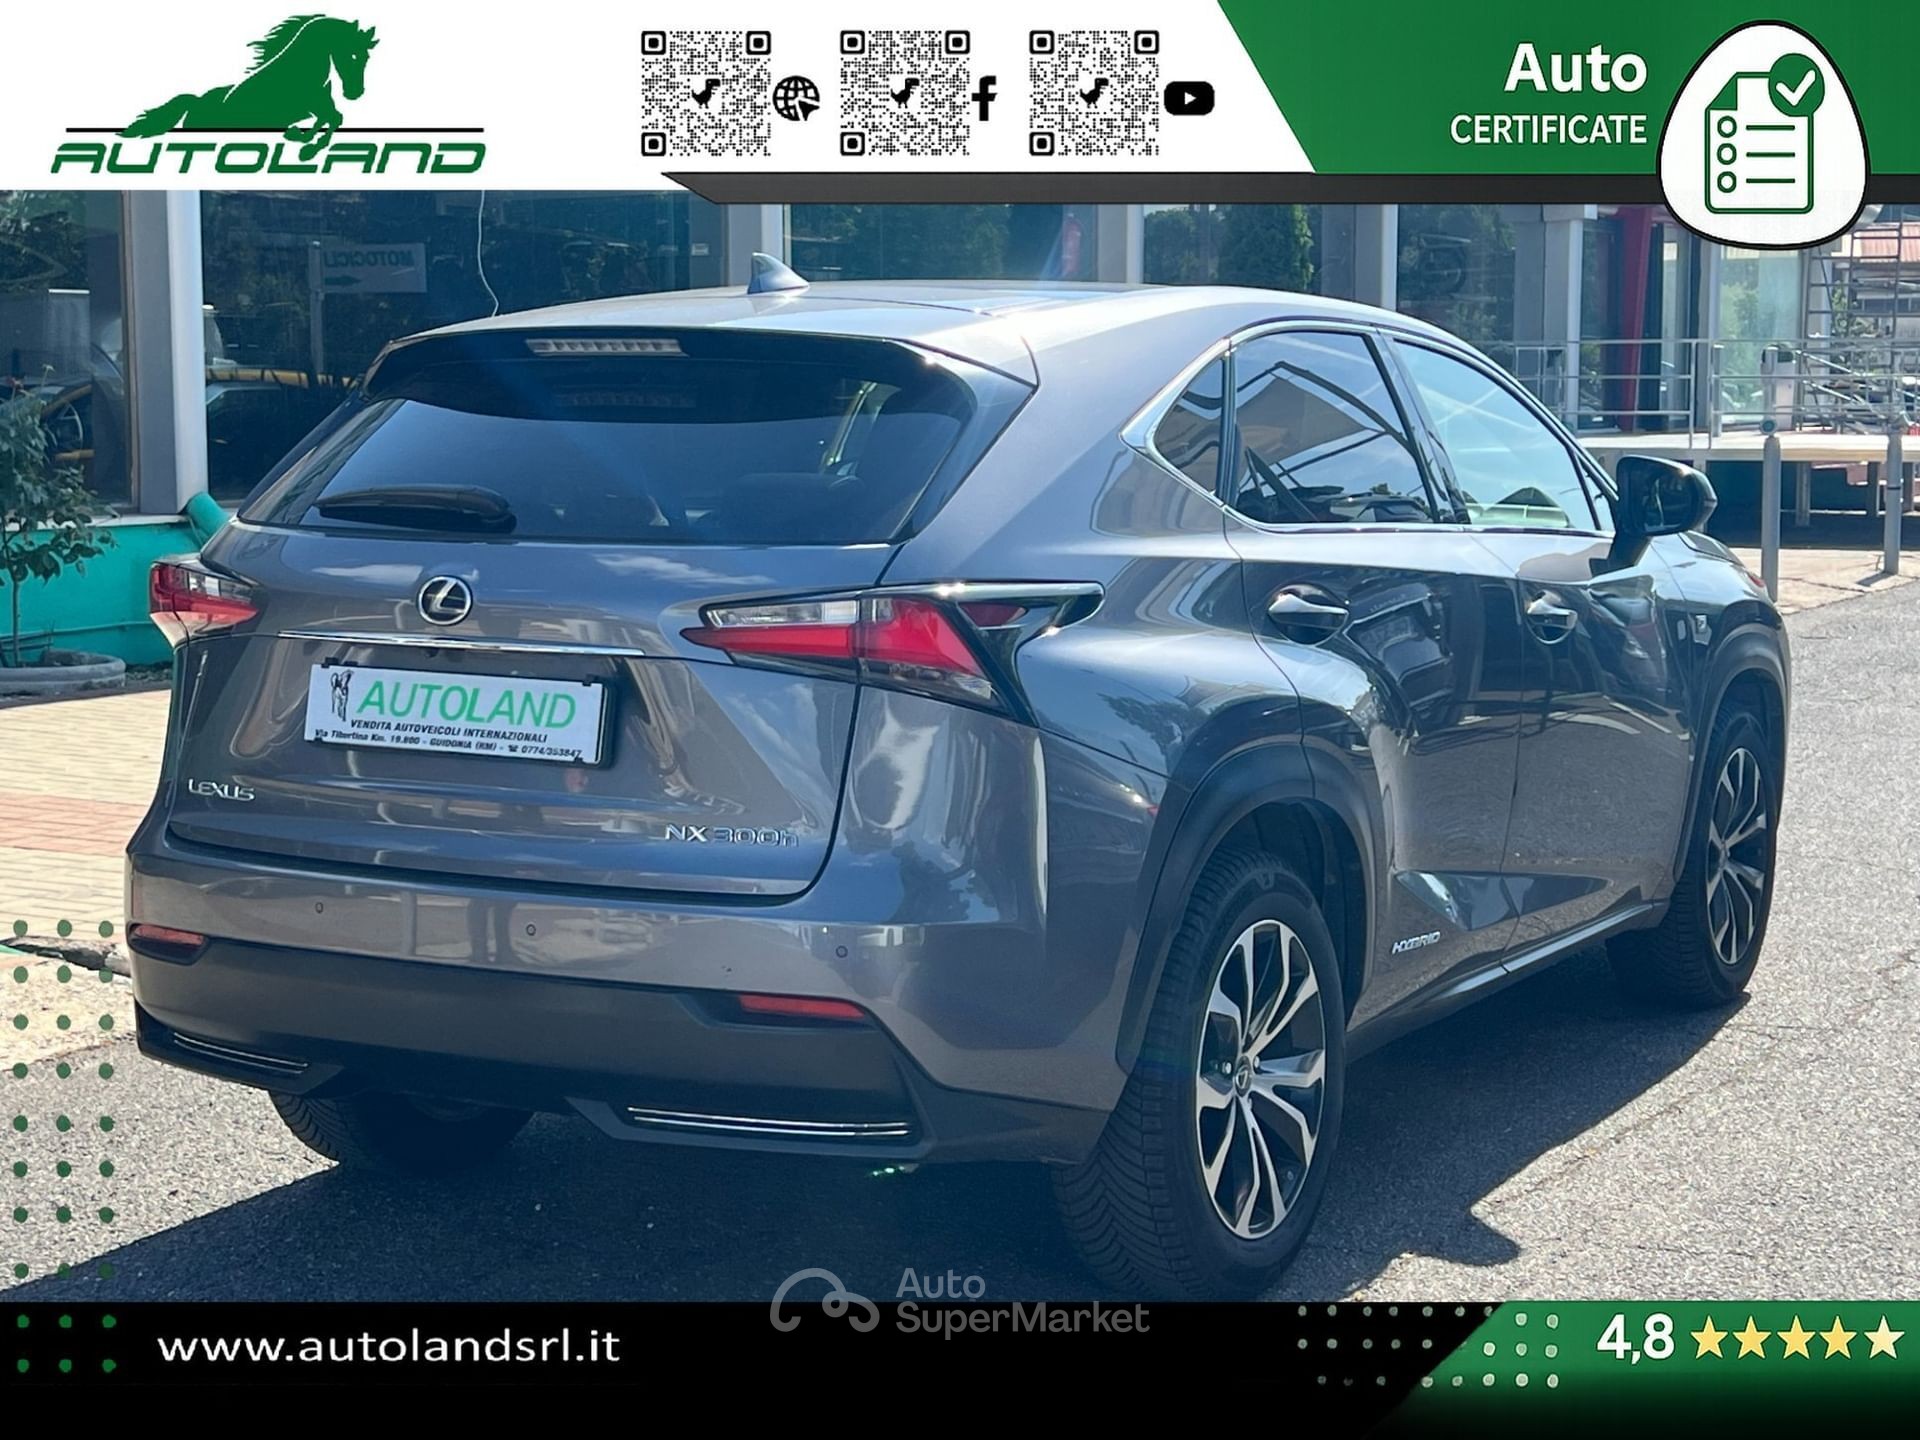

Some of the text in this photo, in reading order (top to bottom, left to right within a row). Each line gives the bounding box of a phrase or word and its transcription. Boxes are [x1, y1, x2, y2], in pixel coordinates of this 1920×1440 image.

[356, 679, 578, 730] AUTOLAND
[315, 729, 328, 738] Via
[331, 730, 369, 741] Tibertina
[429, 738, 472, 749] GUIDONIA
[351, 719, 548, 743] VENDITA AUTOVEICOLI INTERNAZIONALI
[188, 778, 255, 802] LEXUS
[665, 823, 799, 847] NX 300h
[1391, 930, 1441, 955] HYBRID
